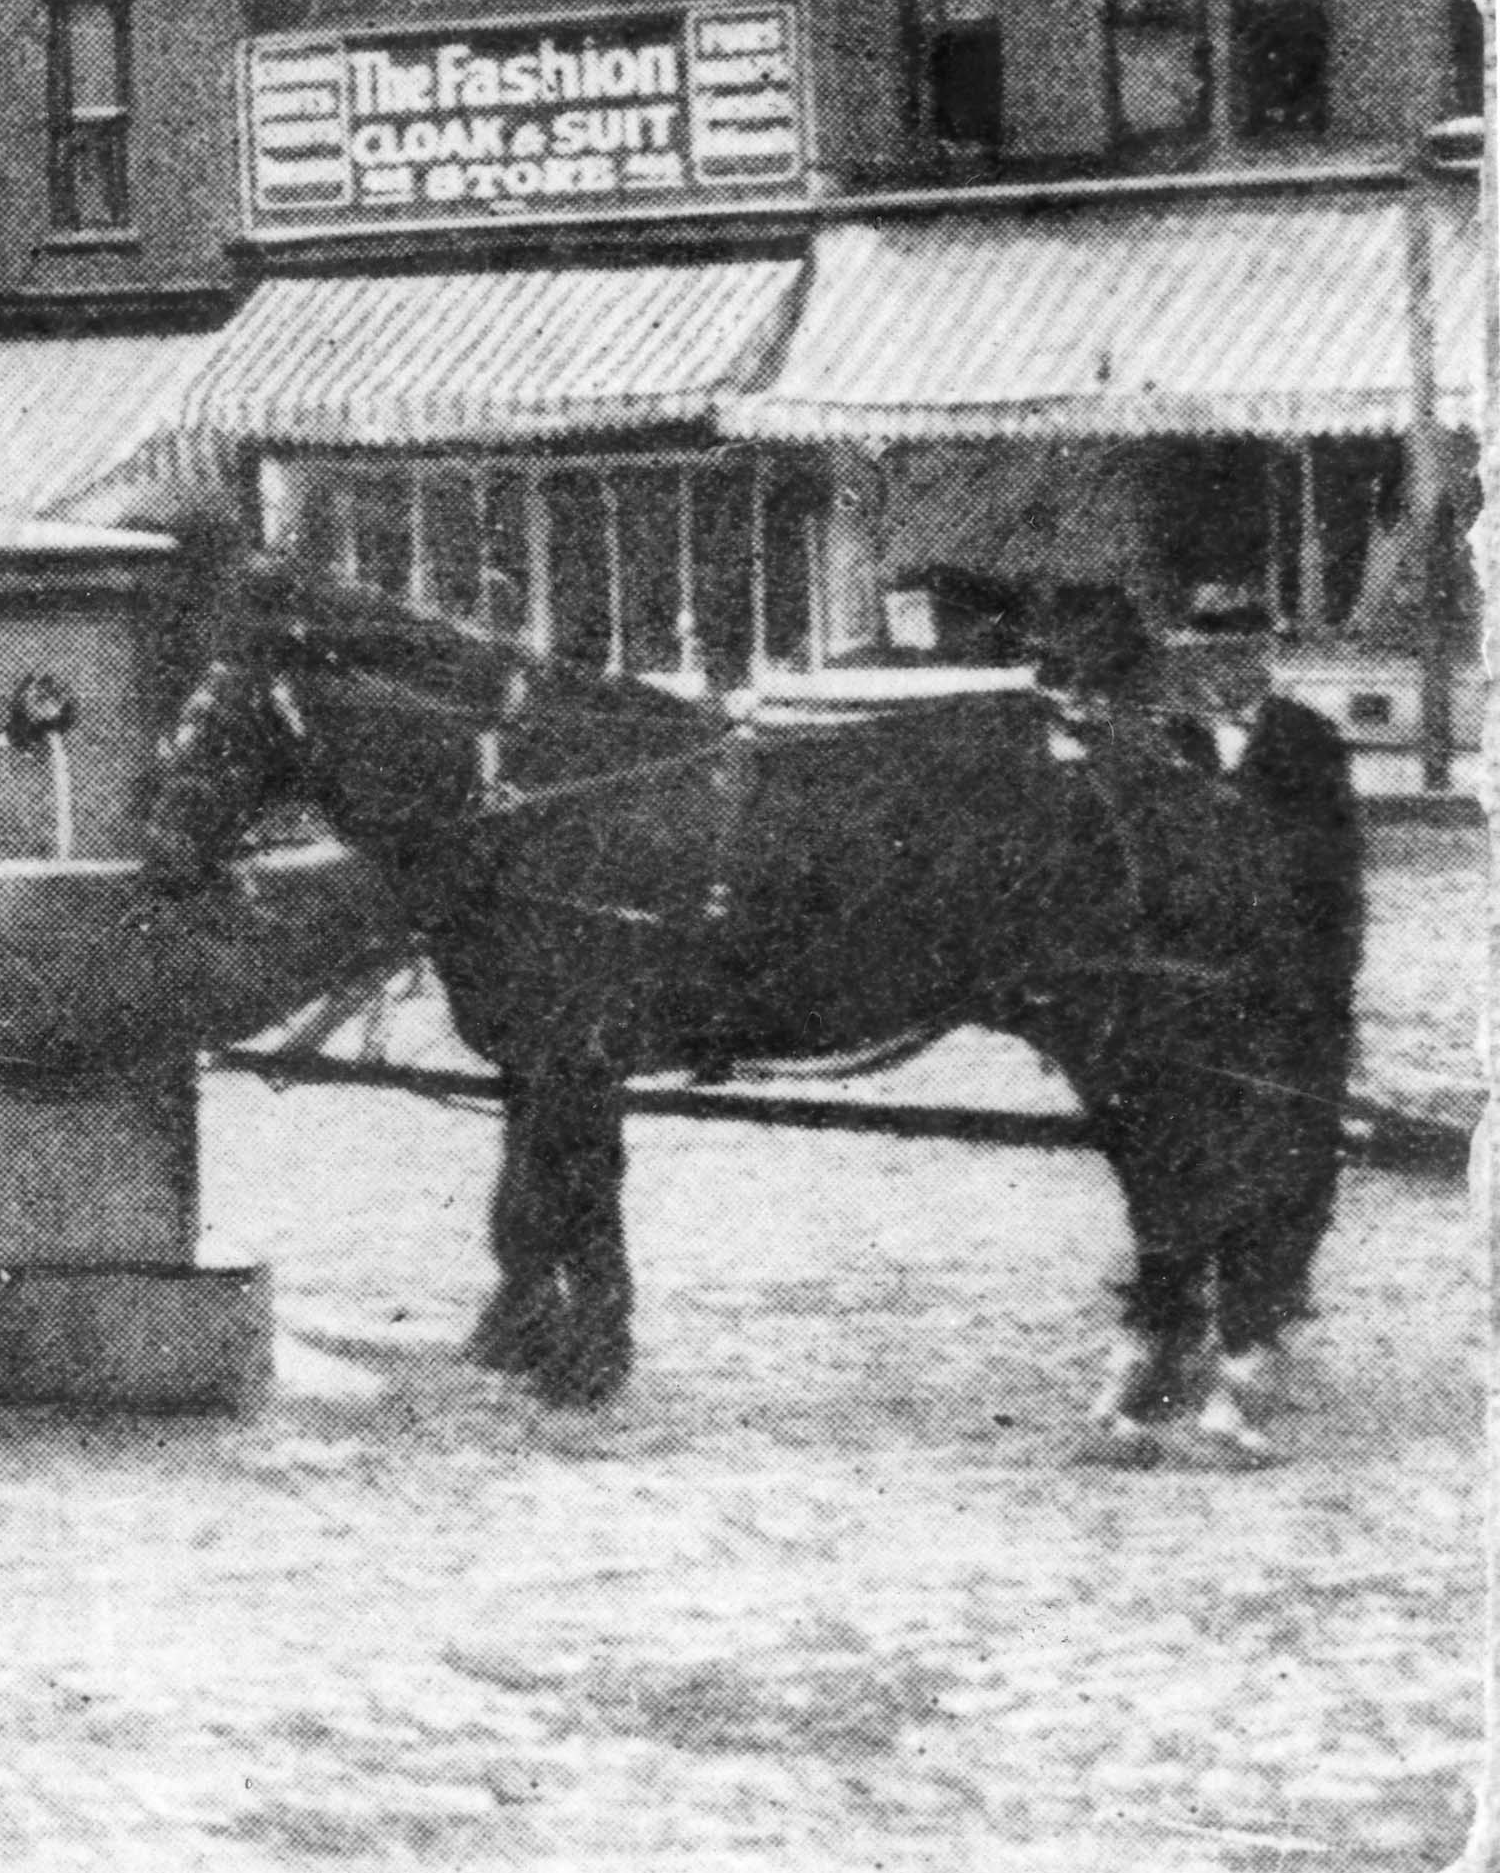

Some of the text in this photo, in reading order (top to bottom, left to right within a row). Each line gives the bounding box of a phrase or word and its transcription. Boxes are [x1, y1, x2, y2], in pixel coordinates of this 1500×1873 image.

[349, 49, 432, 115] The
[436, 37, 678, 109] Fashion
[352, 115, 505, 166] CLOAK
[550, 102, 678, 155] SUIT
[425, 156, 617, 201] STORE
